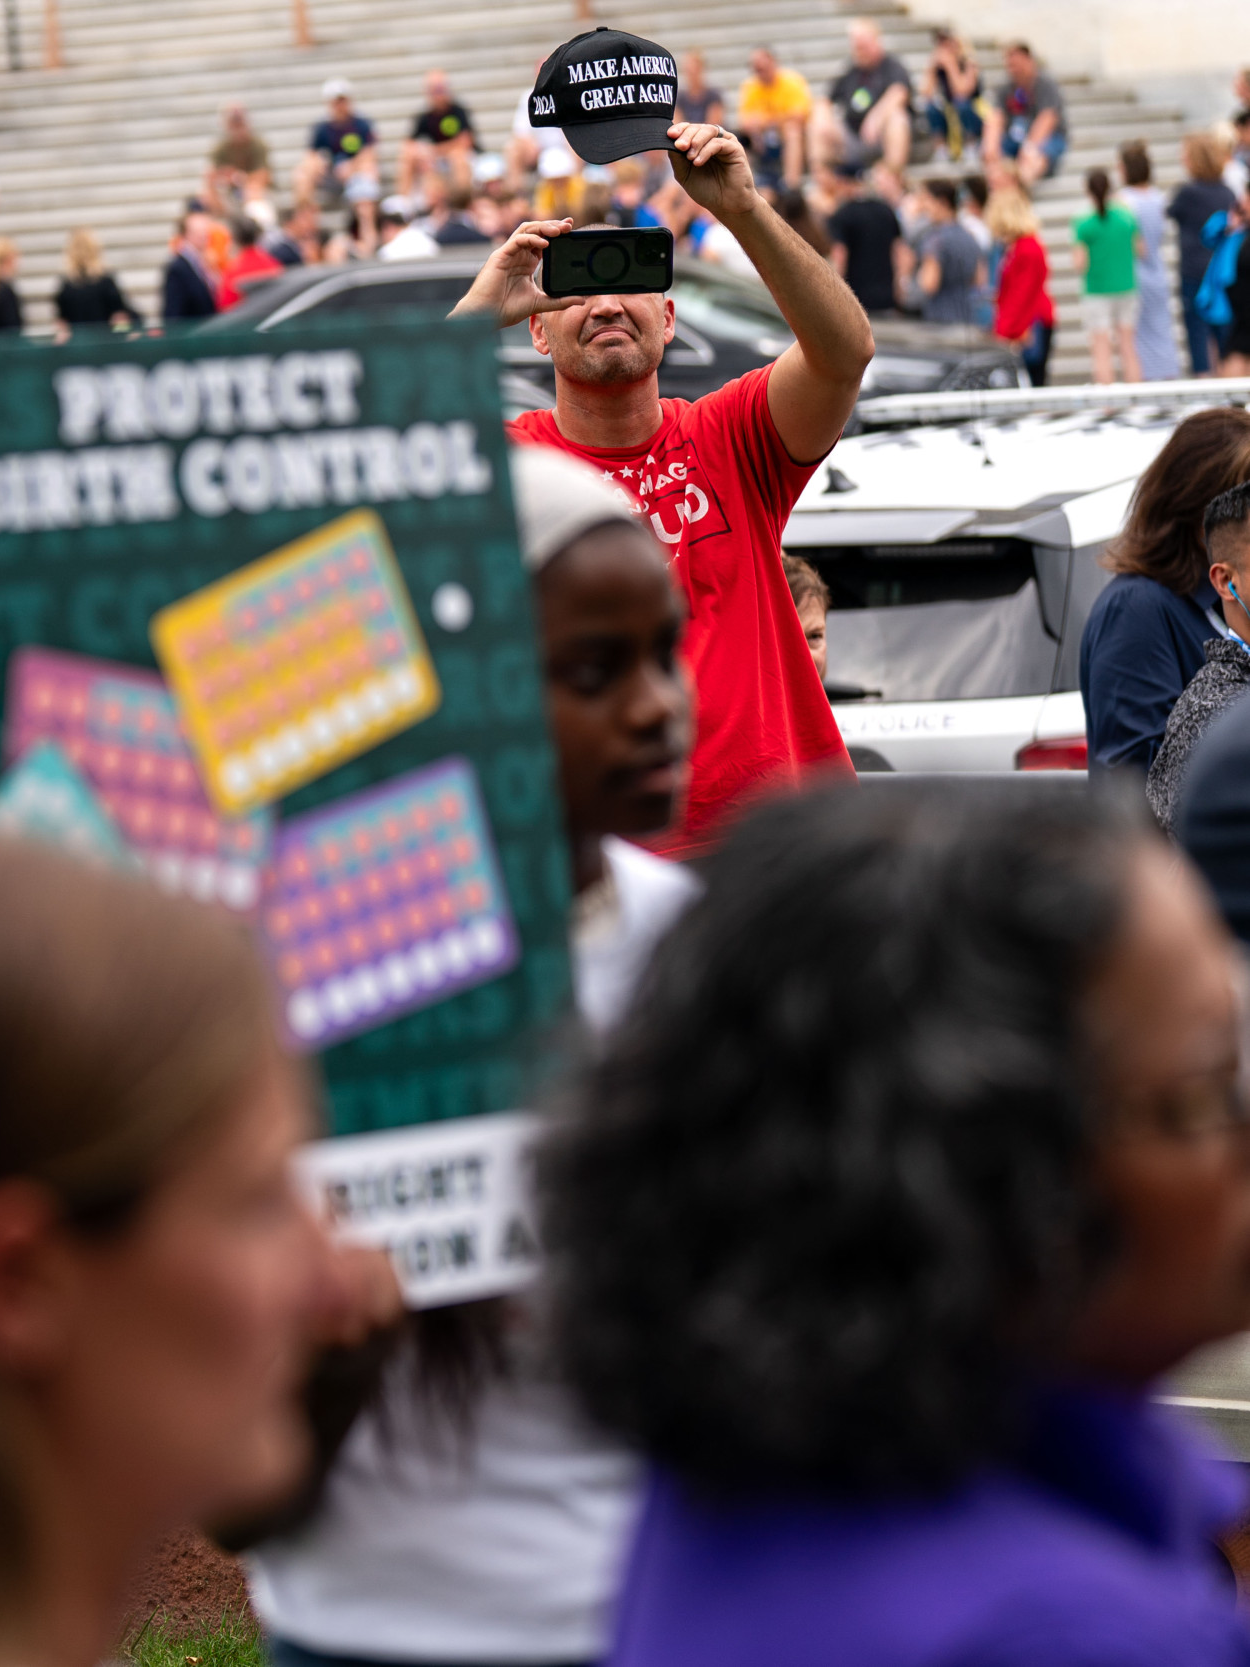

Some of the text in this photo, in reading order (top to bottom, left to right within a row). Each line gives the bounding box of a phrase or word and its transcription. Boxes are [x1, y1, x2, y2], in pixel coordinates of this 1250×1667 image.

[567, 55, 677, 84] MAKE AMERICA
[533, 94, 556, 116] 2024
[580, 84, 673, 111] GREAT AGAIN
[54, 348, 362, 445] PROTECT
[181, 420, 491, 516] CONTROL
[860, 713, 956, 733] POLICE
[327, 1153, 489, 1222] RIGHT
